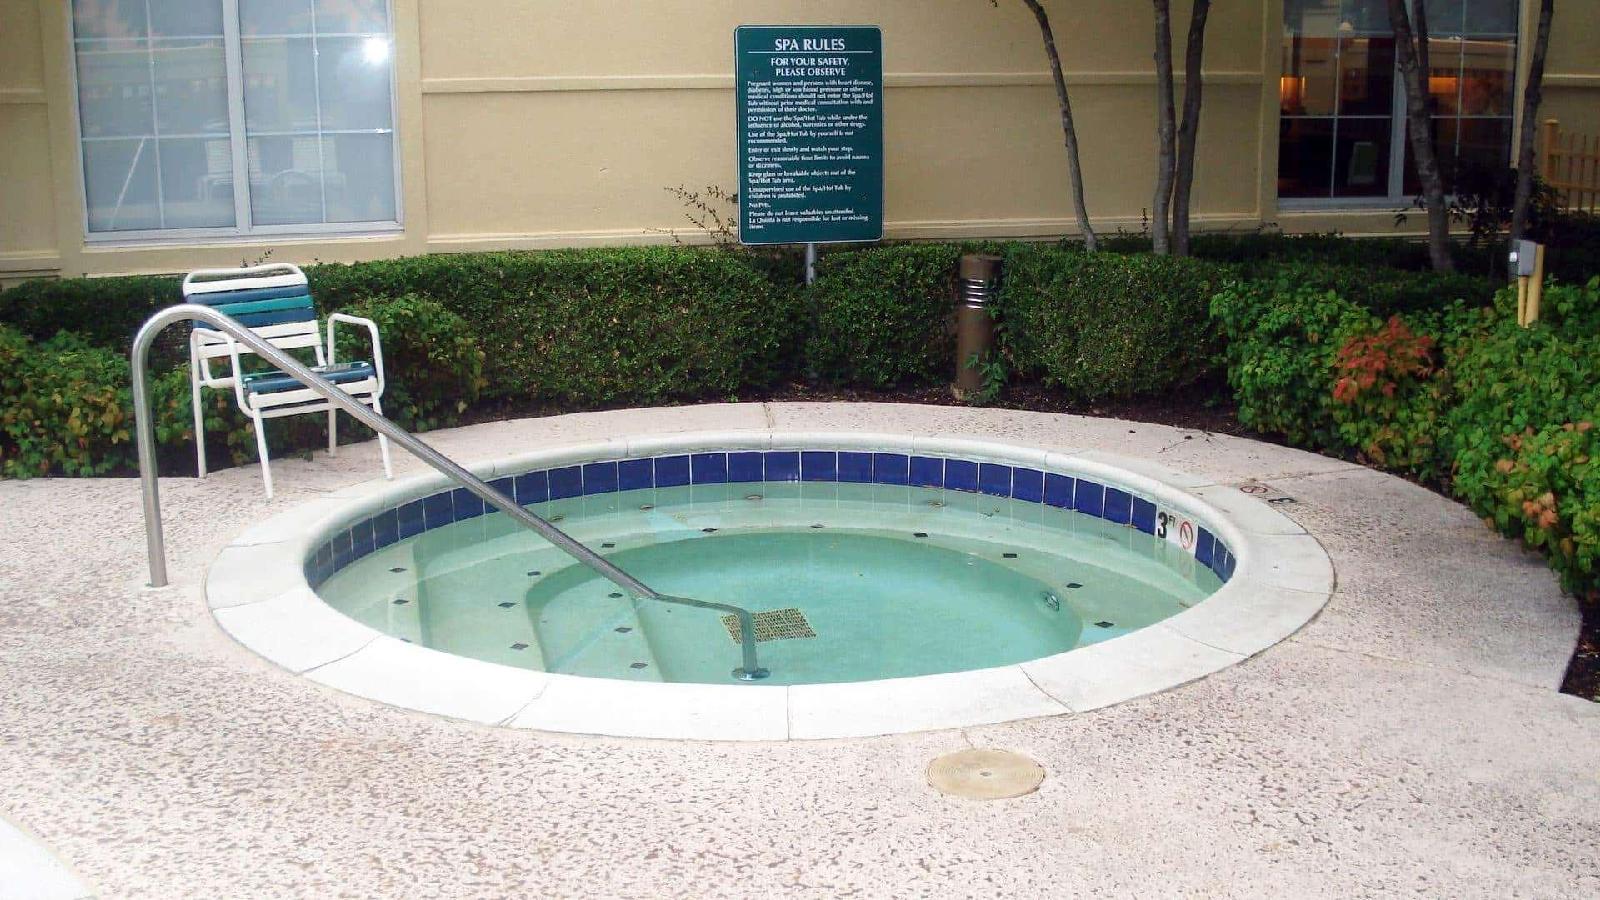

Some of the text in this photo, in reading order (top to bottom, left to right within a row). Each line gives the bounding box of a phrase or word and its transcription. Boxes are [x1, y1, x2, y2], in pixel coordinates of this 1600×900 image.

[774, 38, 845, 51] SPA RULES
[771, 57, 850, 67] FOR YOUR SAFETY,
[776, 67, 846, 76] PLEASE OBSERVE
[1157, 511, 1168, 538] 3
